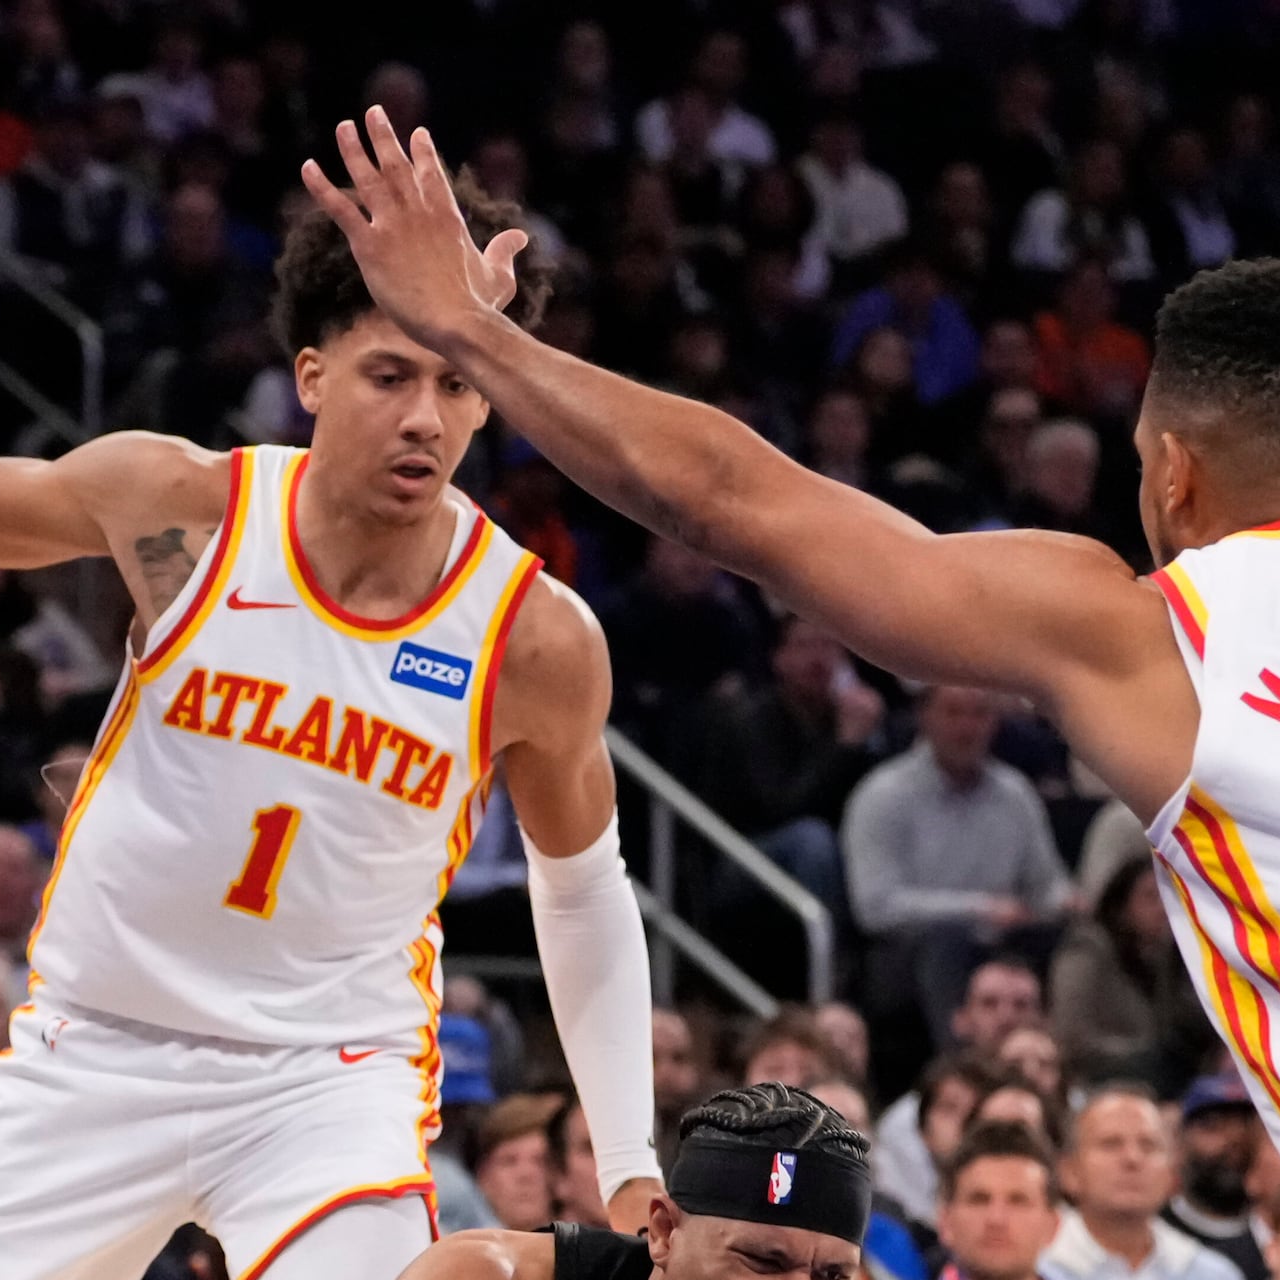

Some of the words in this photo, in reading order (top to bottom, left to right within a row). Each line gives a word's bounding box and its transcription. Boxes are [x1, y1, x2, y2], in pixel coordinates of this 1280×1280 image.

[396, 651, 466, 687] paze
[163, 667, 453, 811] ATLANTA
[223, 802, 302, 920] 1
